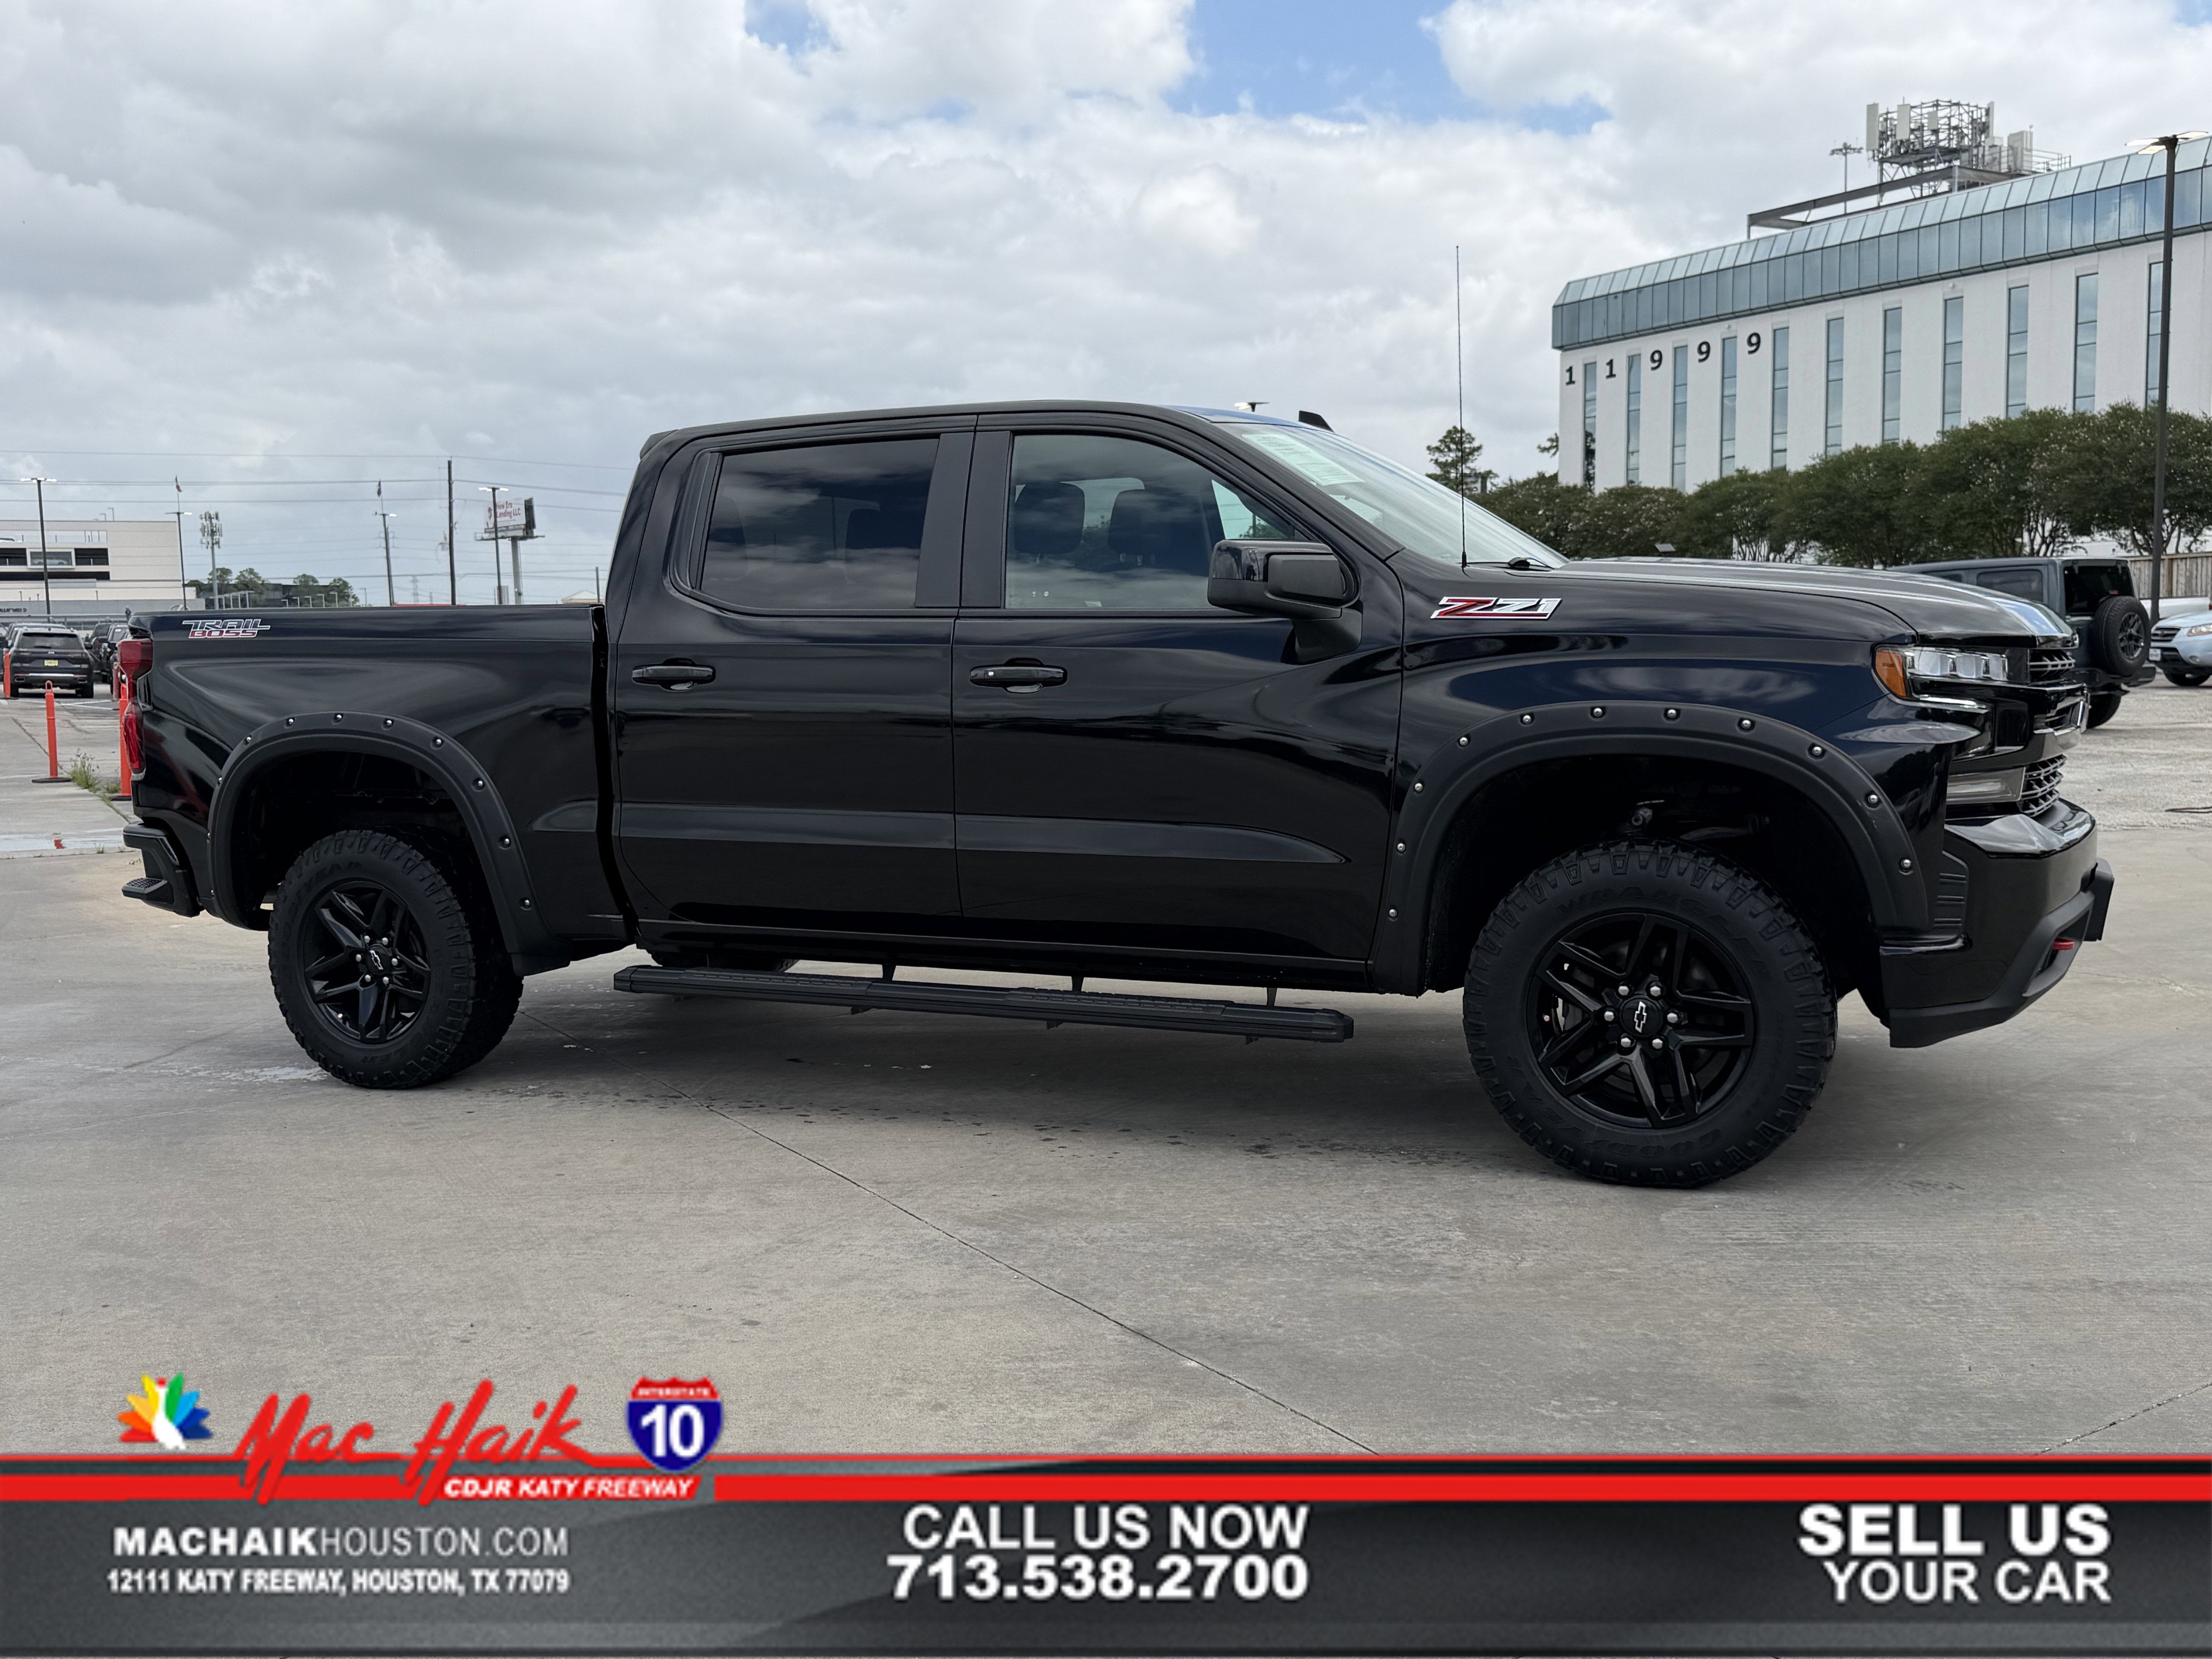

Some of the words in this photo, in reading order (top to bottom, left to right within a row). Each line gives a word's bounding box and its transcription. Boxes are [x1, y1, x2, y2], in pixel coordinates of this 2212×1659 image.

[1431, 596, 1562, 619] Z71
[182, 619, 271, 630] TRAIL
[189, 629, 258, 638] BOSS
[1557, 886, 1774, 979] WRANGLER
